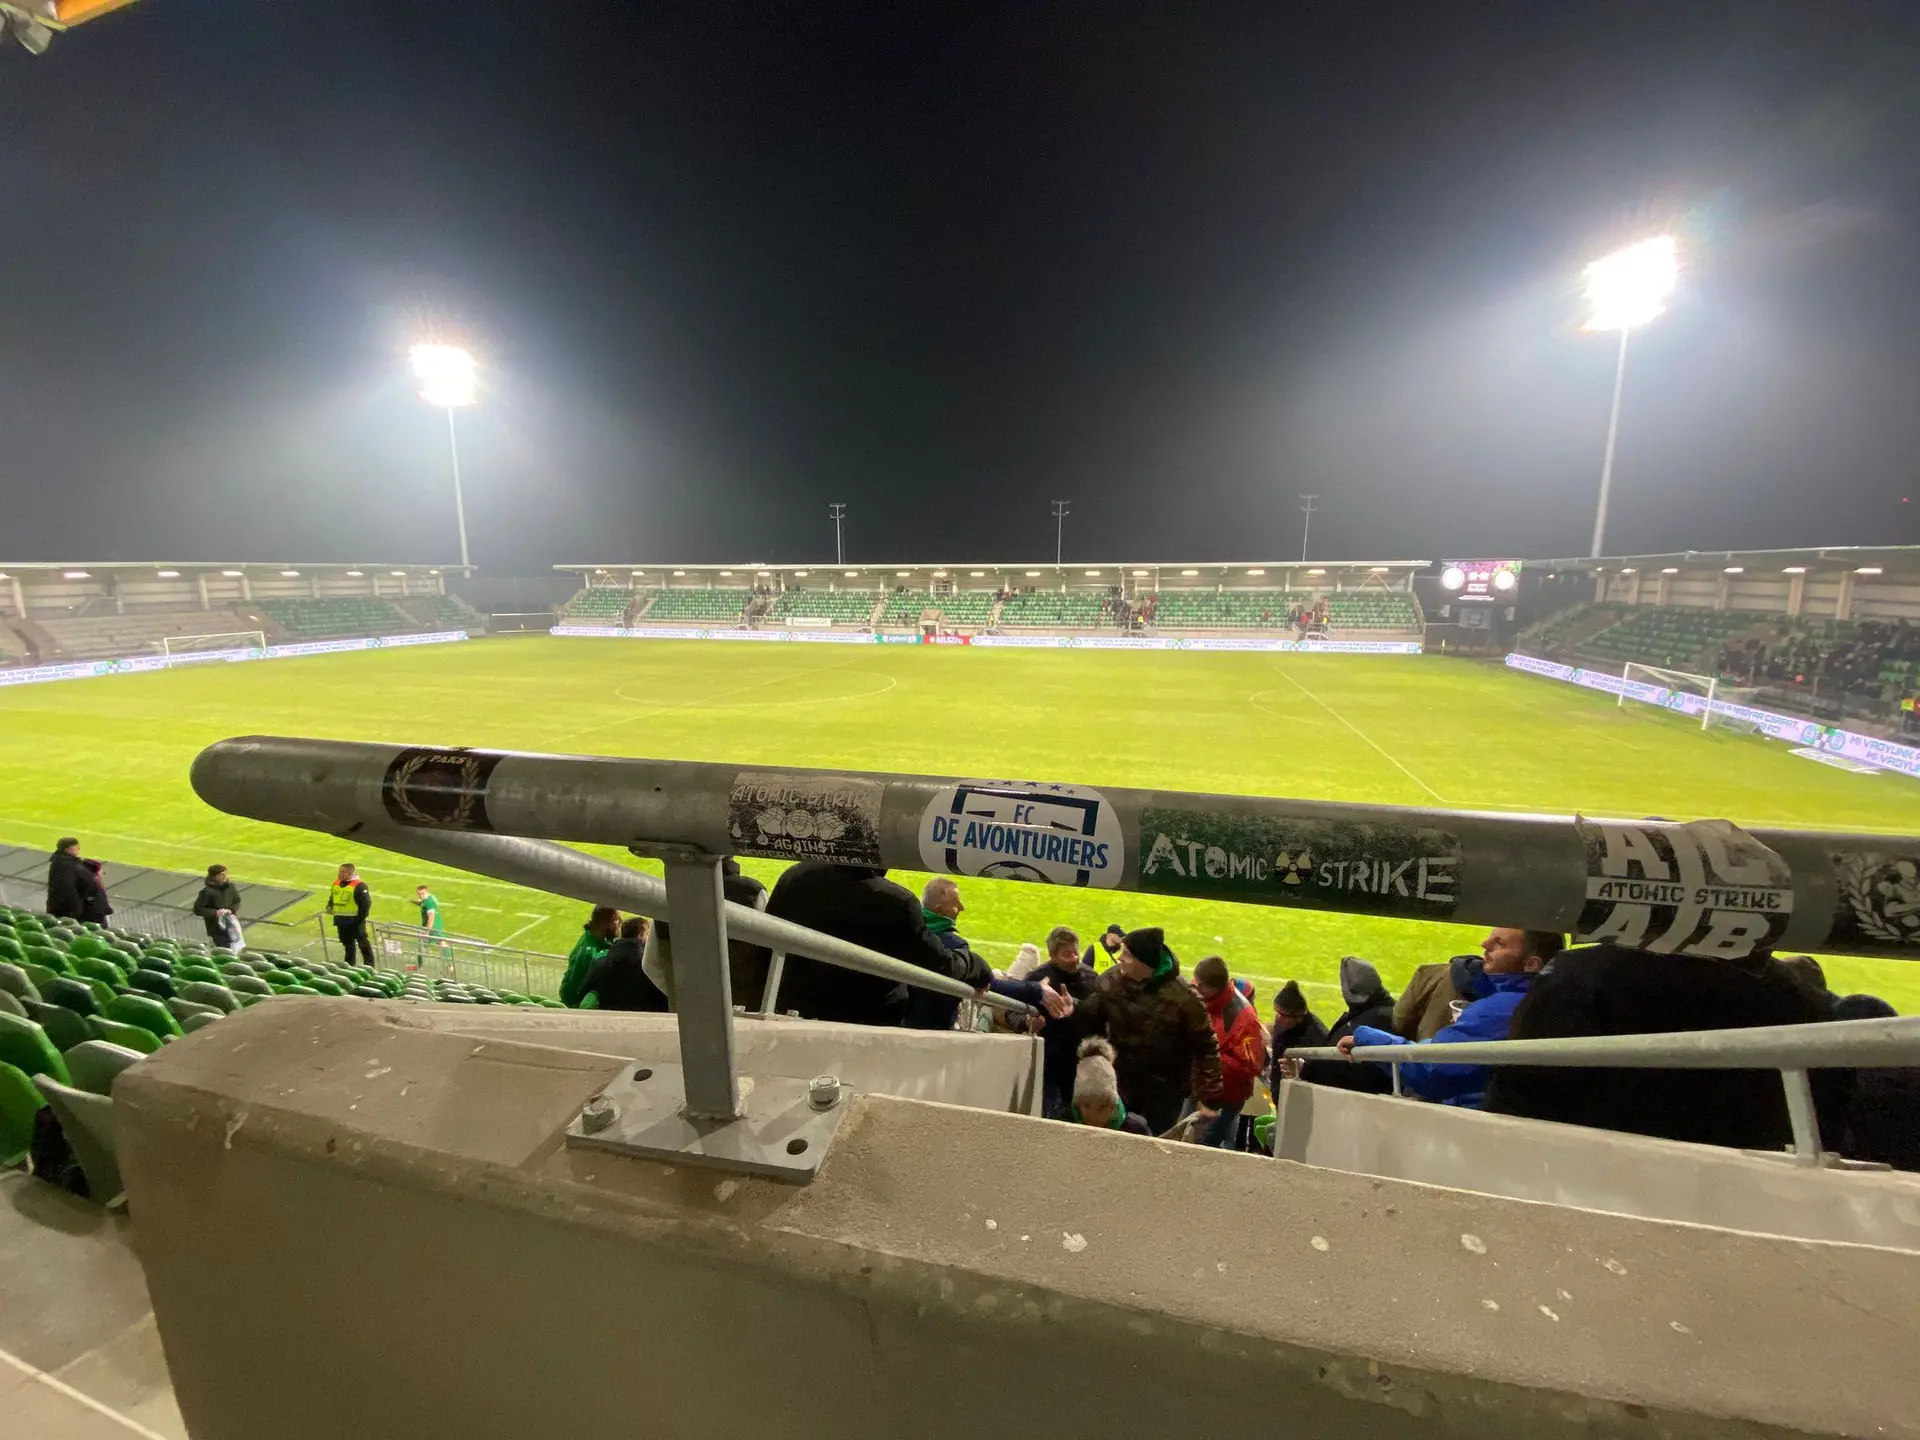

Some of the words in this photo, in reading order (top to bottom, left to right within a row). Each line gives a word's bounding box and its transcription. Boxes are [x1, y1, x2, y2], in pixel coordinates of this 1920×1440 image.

[1013, 804, 1036, 825] FC
[774, 838, 836, 854] AGAINST
[932, 815, 960, 845] DE
[963, 821, 1109, 870] AVONTURIERS
[1142, 832, 1268, 881] ATOMIC
[1318, 857, 1457, 902] STRIKE
[1598, 881, 1685, 903] ATOMIC
[1694, 887, 1782, 910] STRIKE
